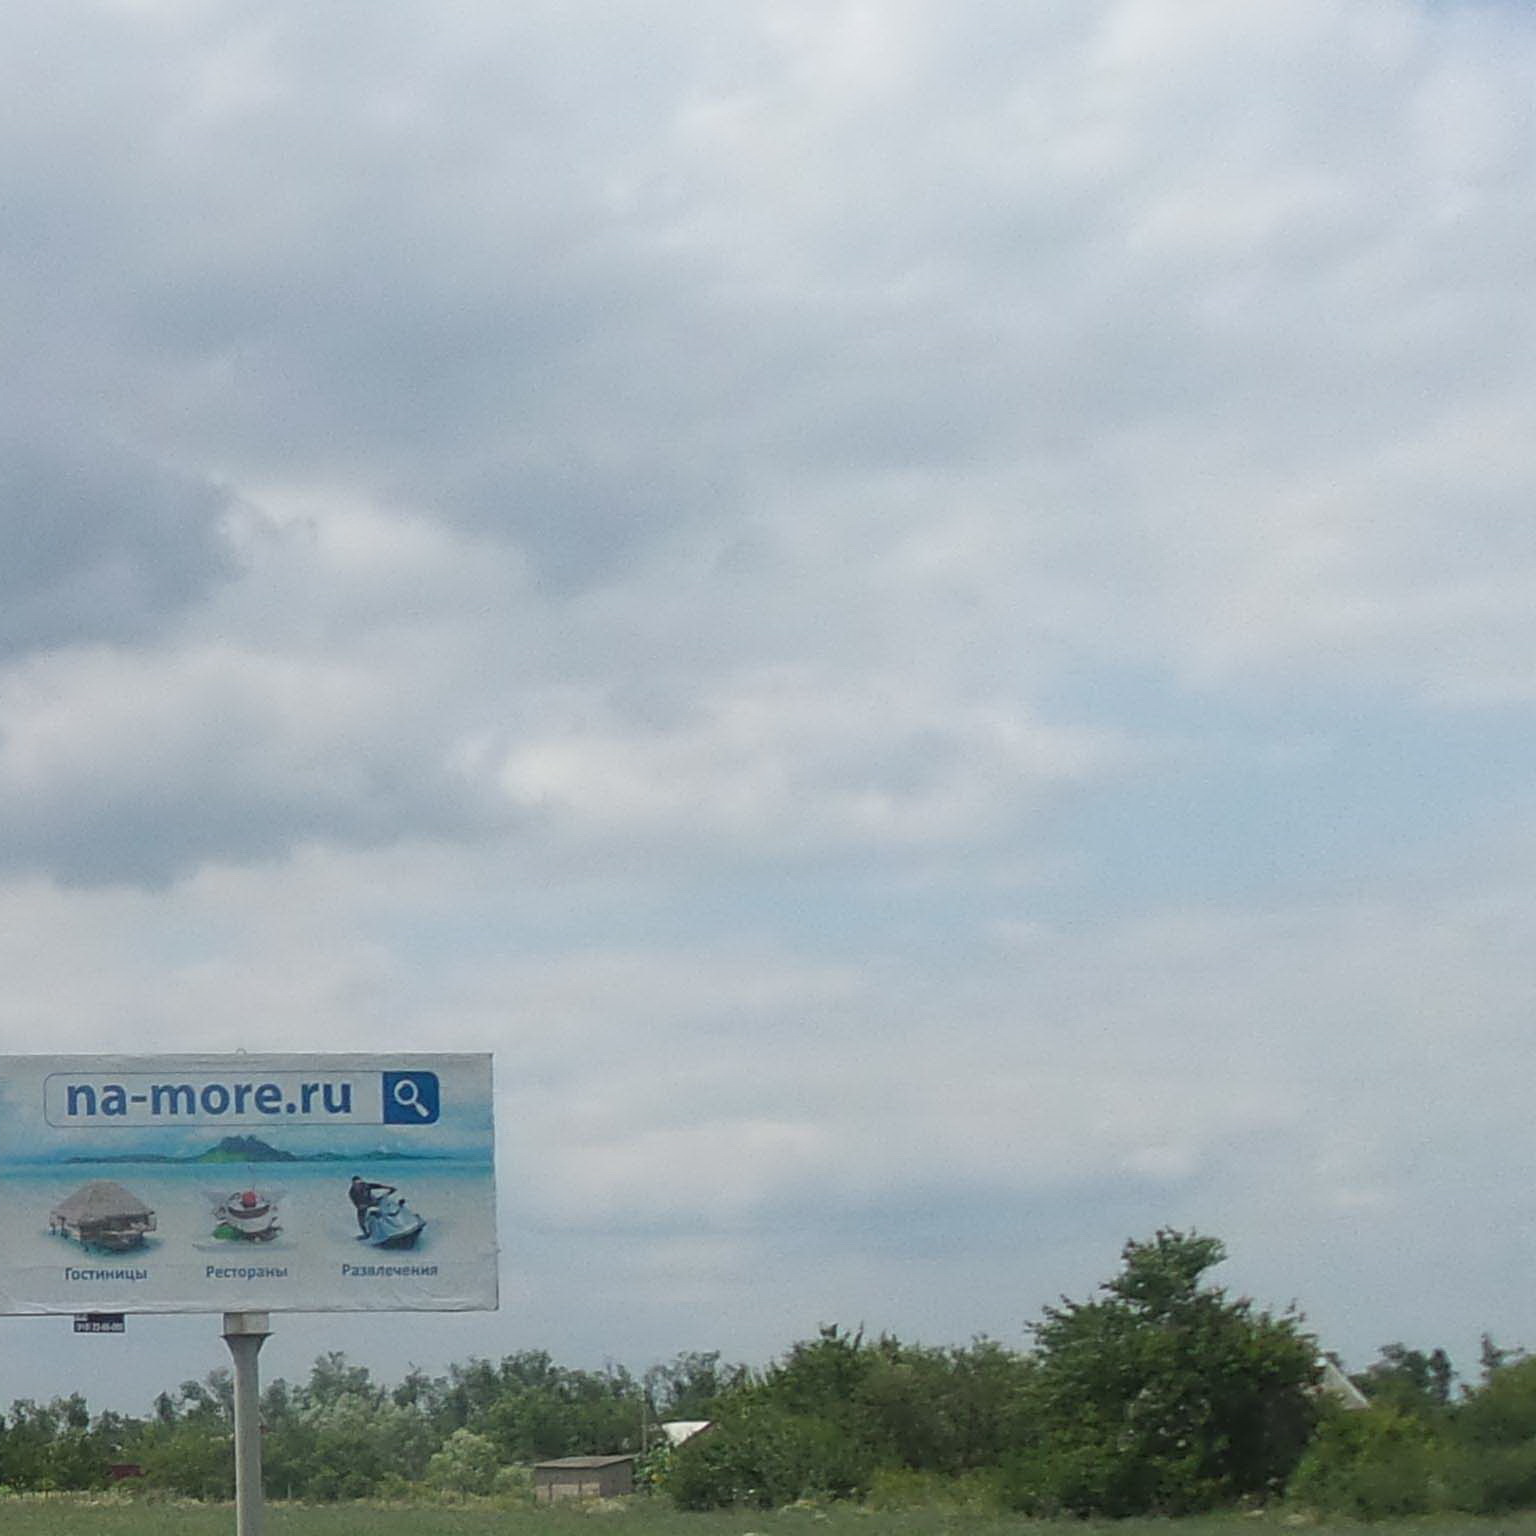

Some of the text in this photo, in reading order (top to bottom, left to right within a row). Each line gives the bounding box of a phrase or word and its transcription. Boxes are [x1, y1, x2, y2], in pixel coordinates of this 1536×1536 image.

[66, 1081, 352, 1117] na-more.ru
[64, 1267, 148, 1281] Гостиницы
[205, 1265, 289, 1280] Рестораны
[341, 1263, 439, 1277] Развлечения
